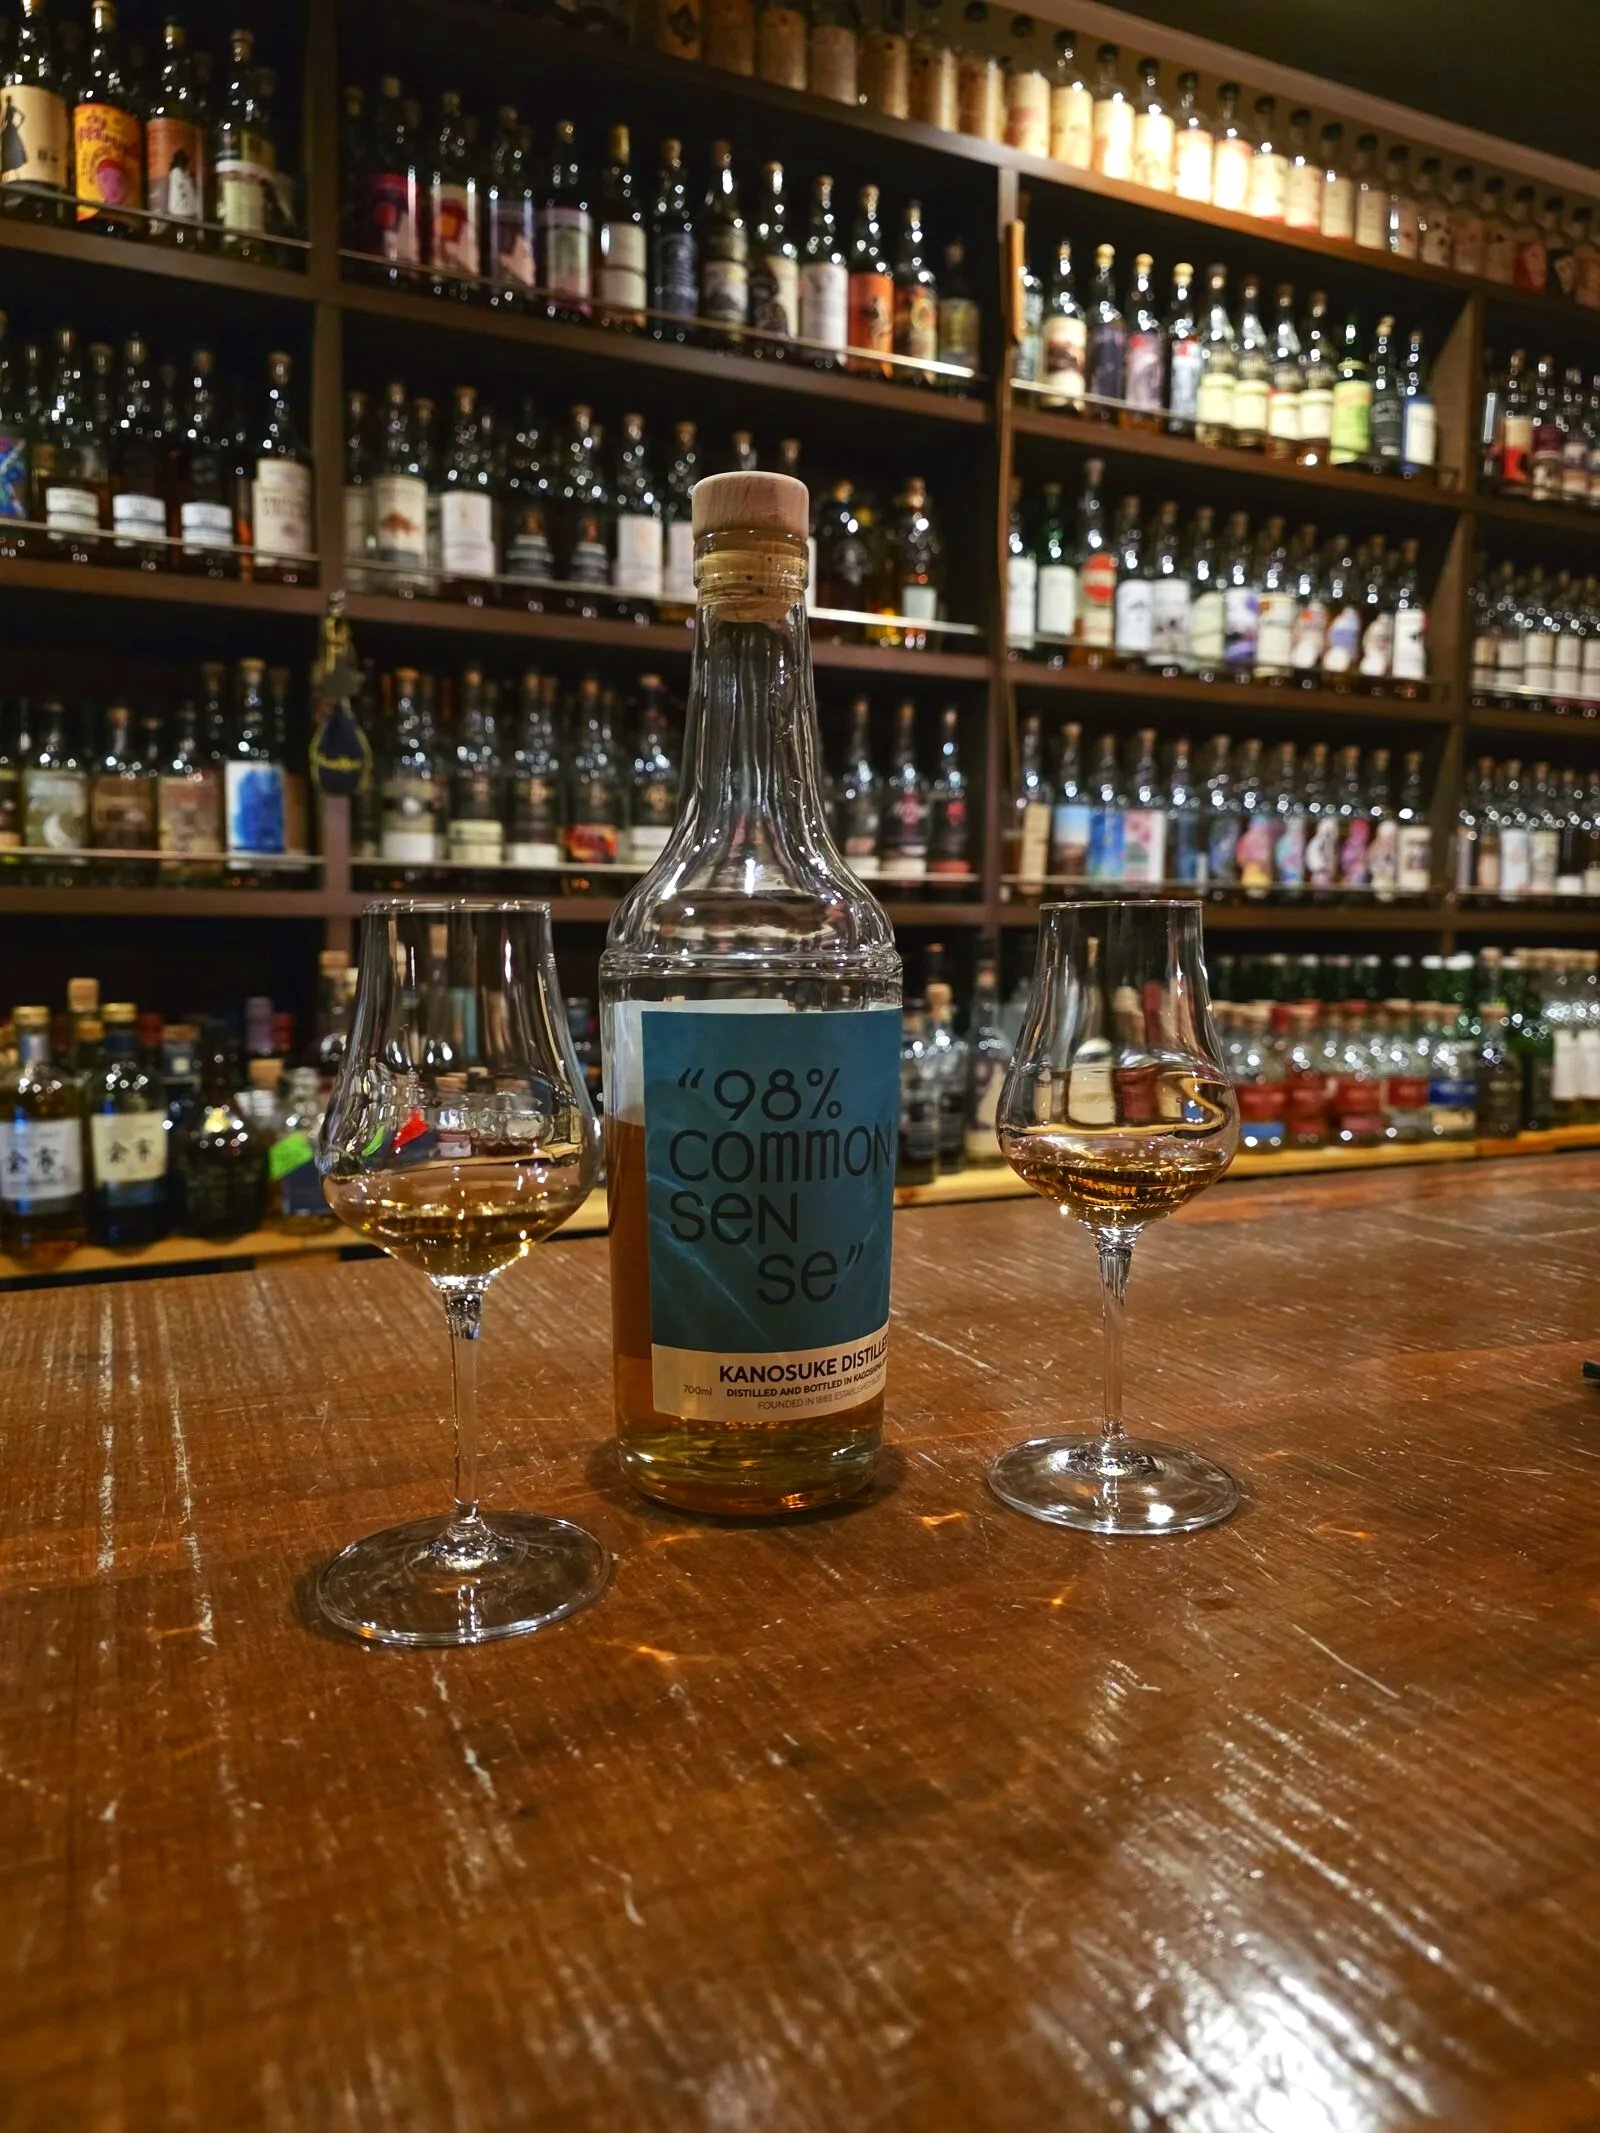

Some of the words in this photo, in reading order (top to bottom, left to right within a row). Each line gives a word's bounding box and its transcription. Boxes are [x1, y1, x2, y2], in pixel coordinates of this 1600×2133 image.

[719, 1357, 838, 1383] KANOSUKE
[683, 1384, 713, 1397] 700ml
[726, 1387, 778, 1398] DISTILLED
[780, 1386, 802, 1397] AND
[803, 1378, 843, 1394] BOTTLED
[843, 1376, 853, 1386] IN
[758, 1398, 804, 1410] FOUNDED
[805, 1397, 815, 1406] IN
